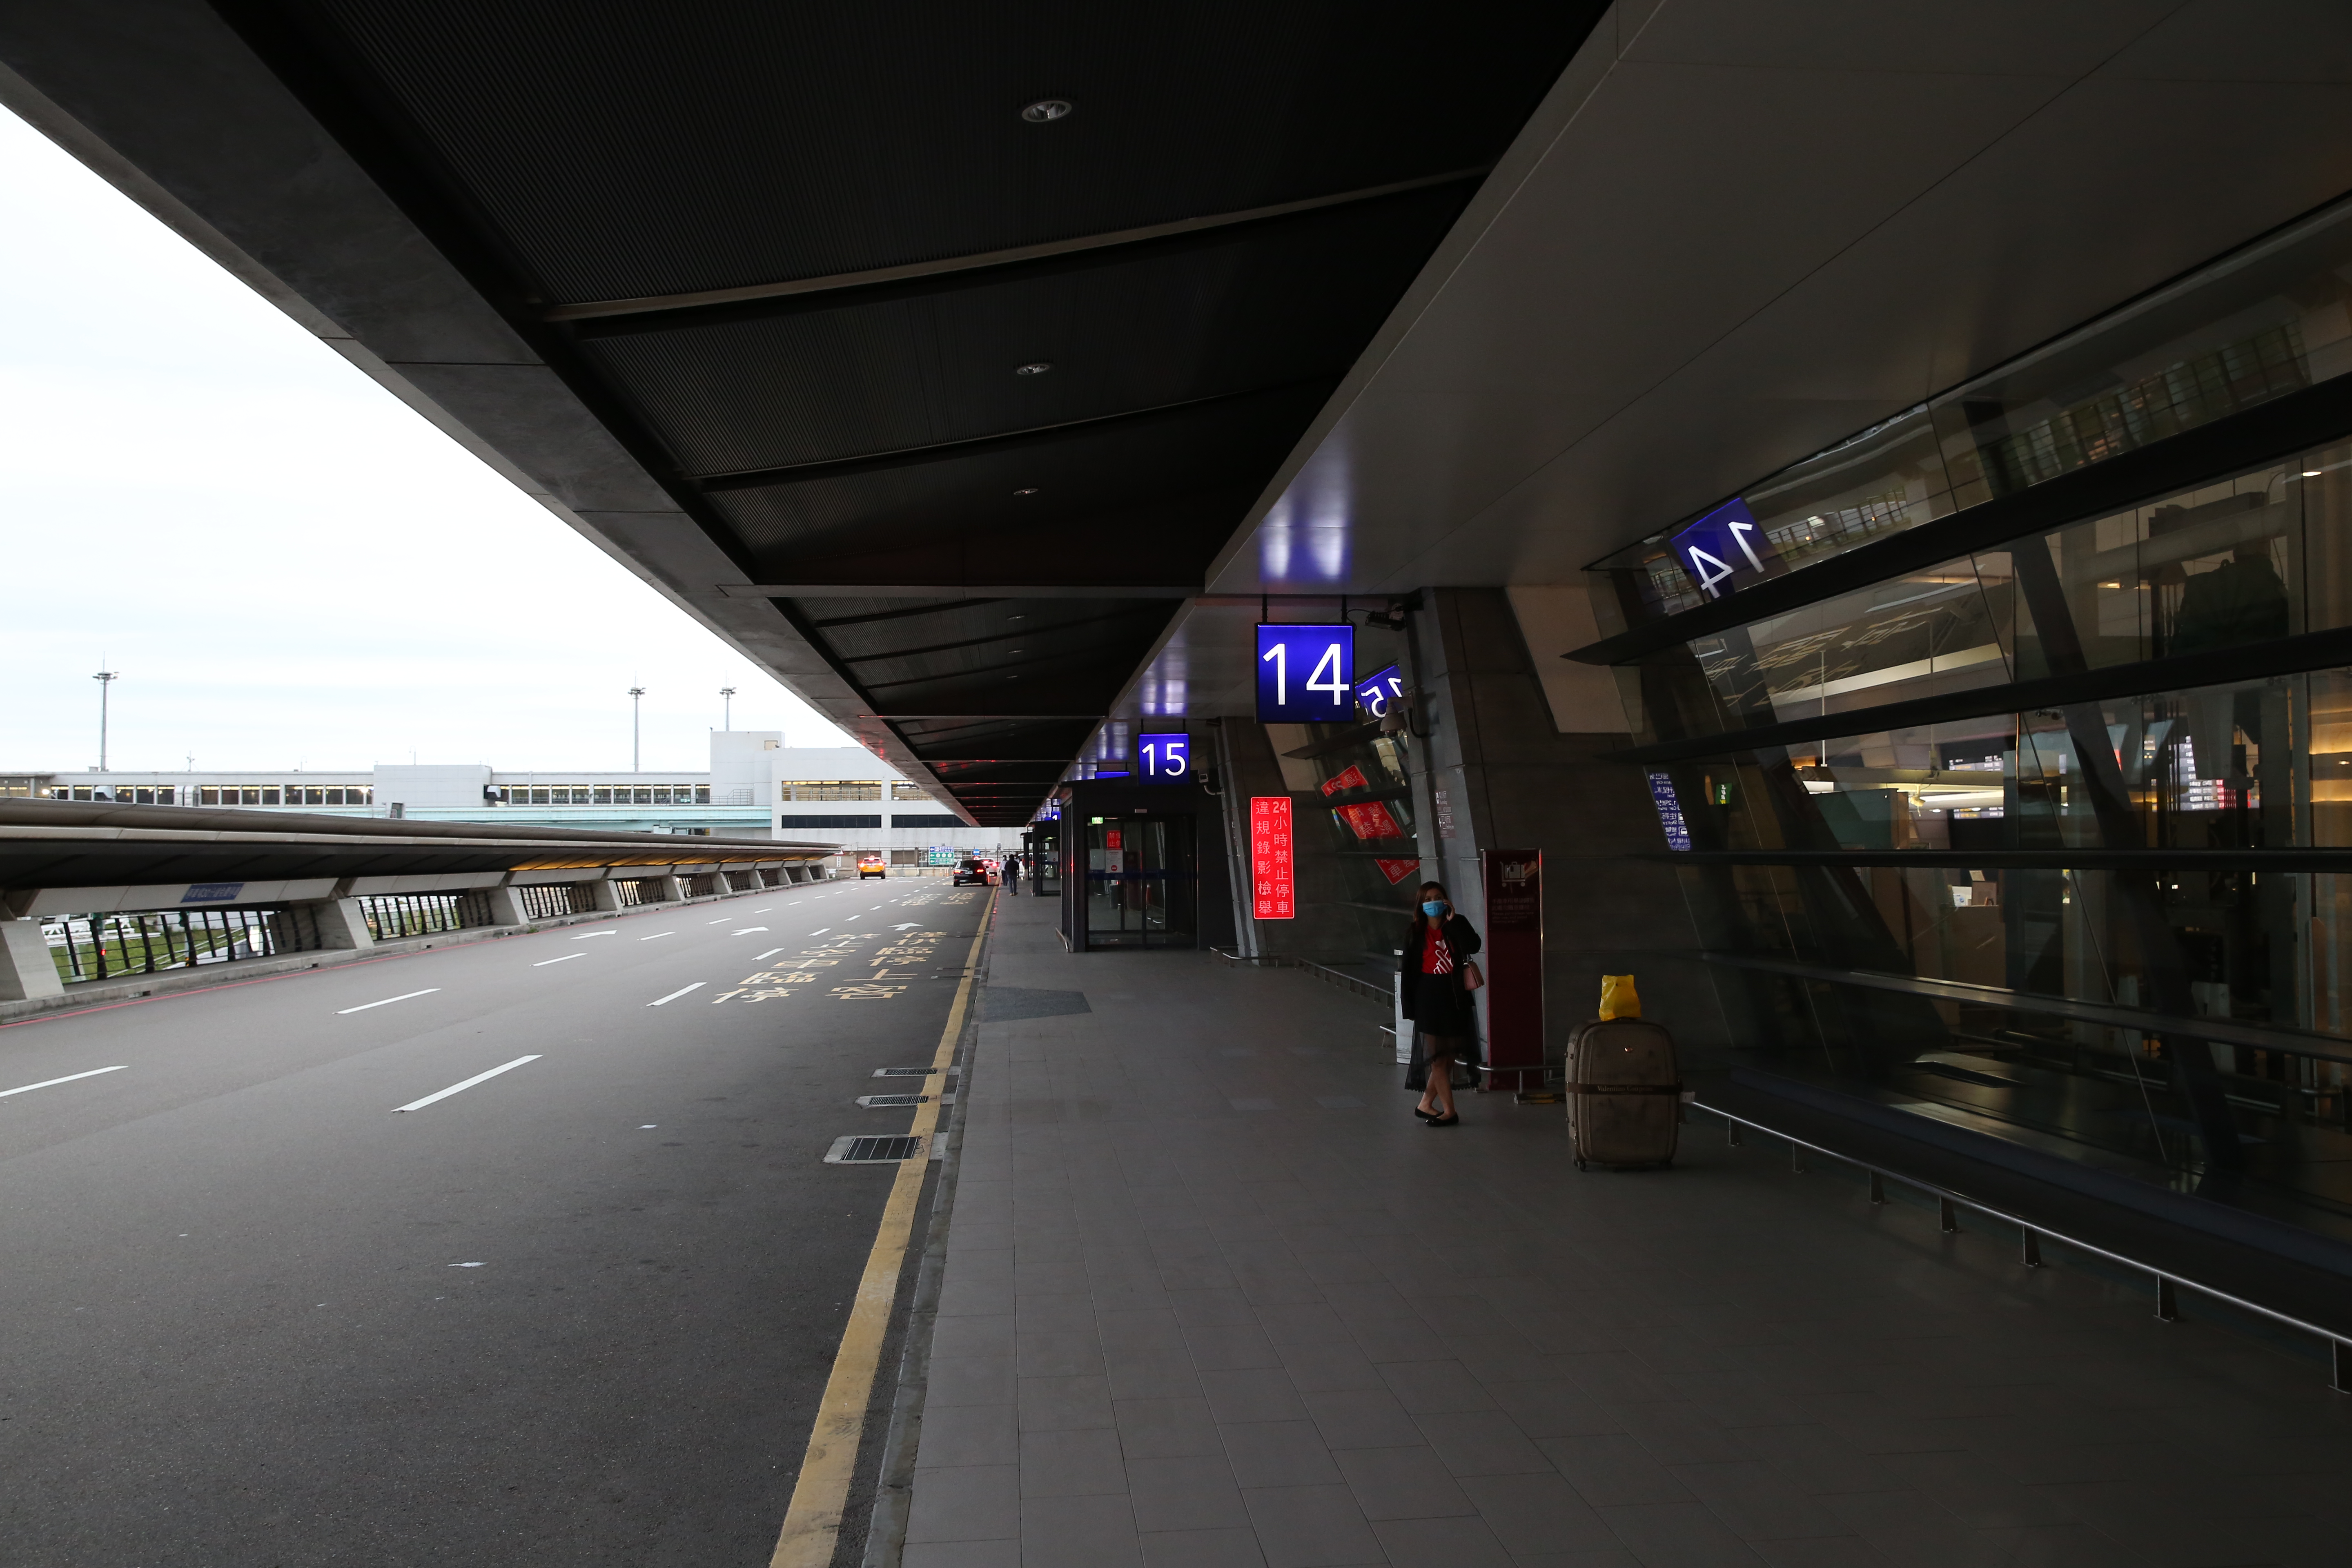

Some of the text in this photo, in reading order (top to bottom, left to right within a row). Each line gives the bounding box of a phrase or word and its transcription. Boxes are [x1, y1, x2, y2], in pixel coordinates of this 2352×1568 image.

[1263, 643, 1350, 705] 14
[1142, 743, 1186, 776] 15
[1256, 801, 1272, 915] 違規錄影檢舉
[1273, 801, 1290, 915] 24小時禁止停車
